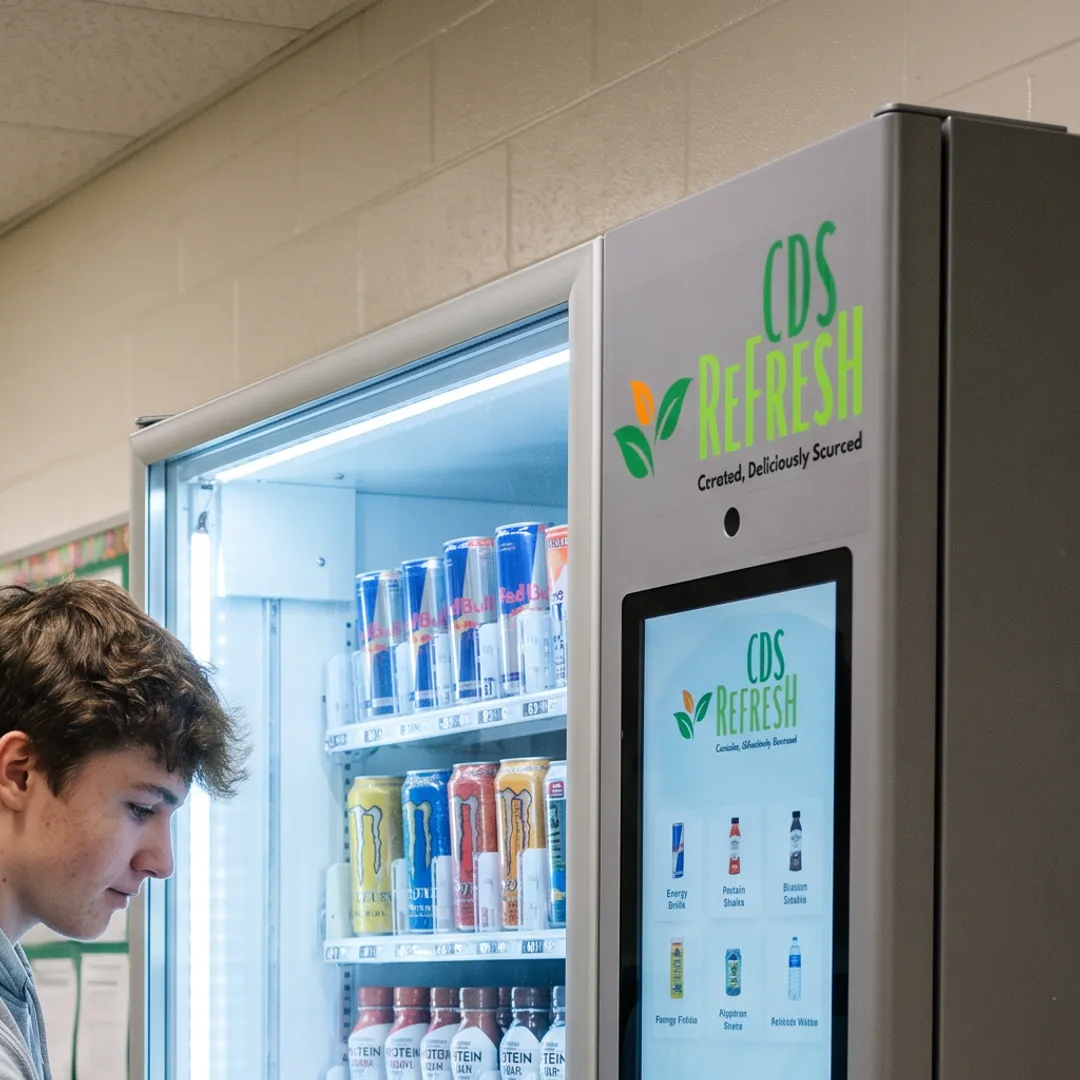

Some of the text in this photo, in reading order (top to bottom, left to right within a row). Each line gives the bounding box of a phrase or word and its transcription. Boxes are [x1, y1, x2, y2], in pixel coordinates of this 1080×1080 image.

[763, 220, 837, 343] CDS
[748, 446, 810, 479] Deliciously
[746, 628, 785, 684] CDS
[666, 889, 687, 900] Energy
